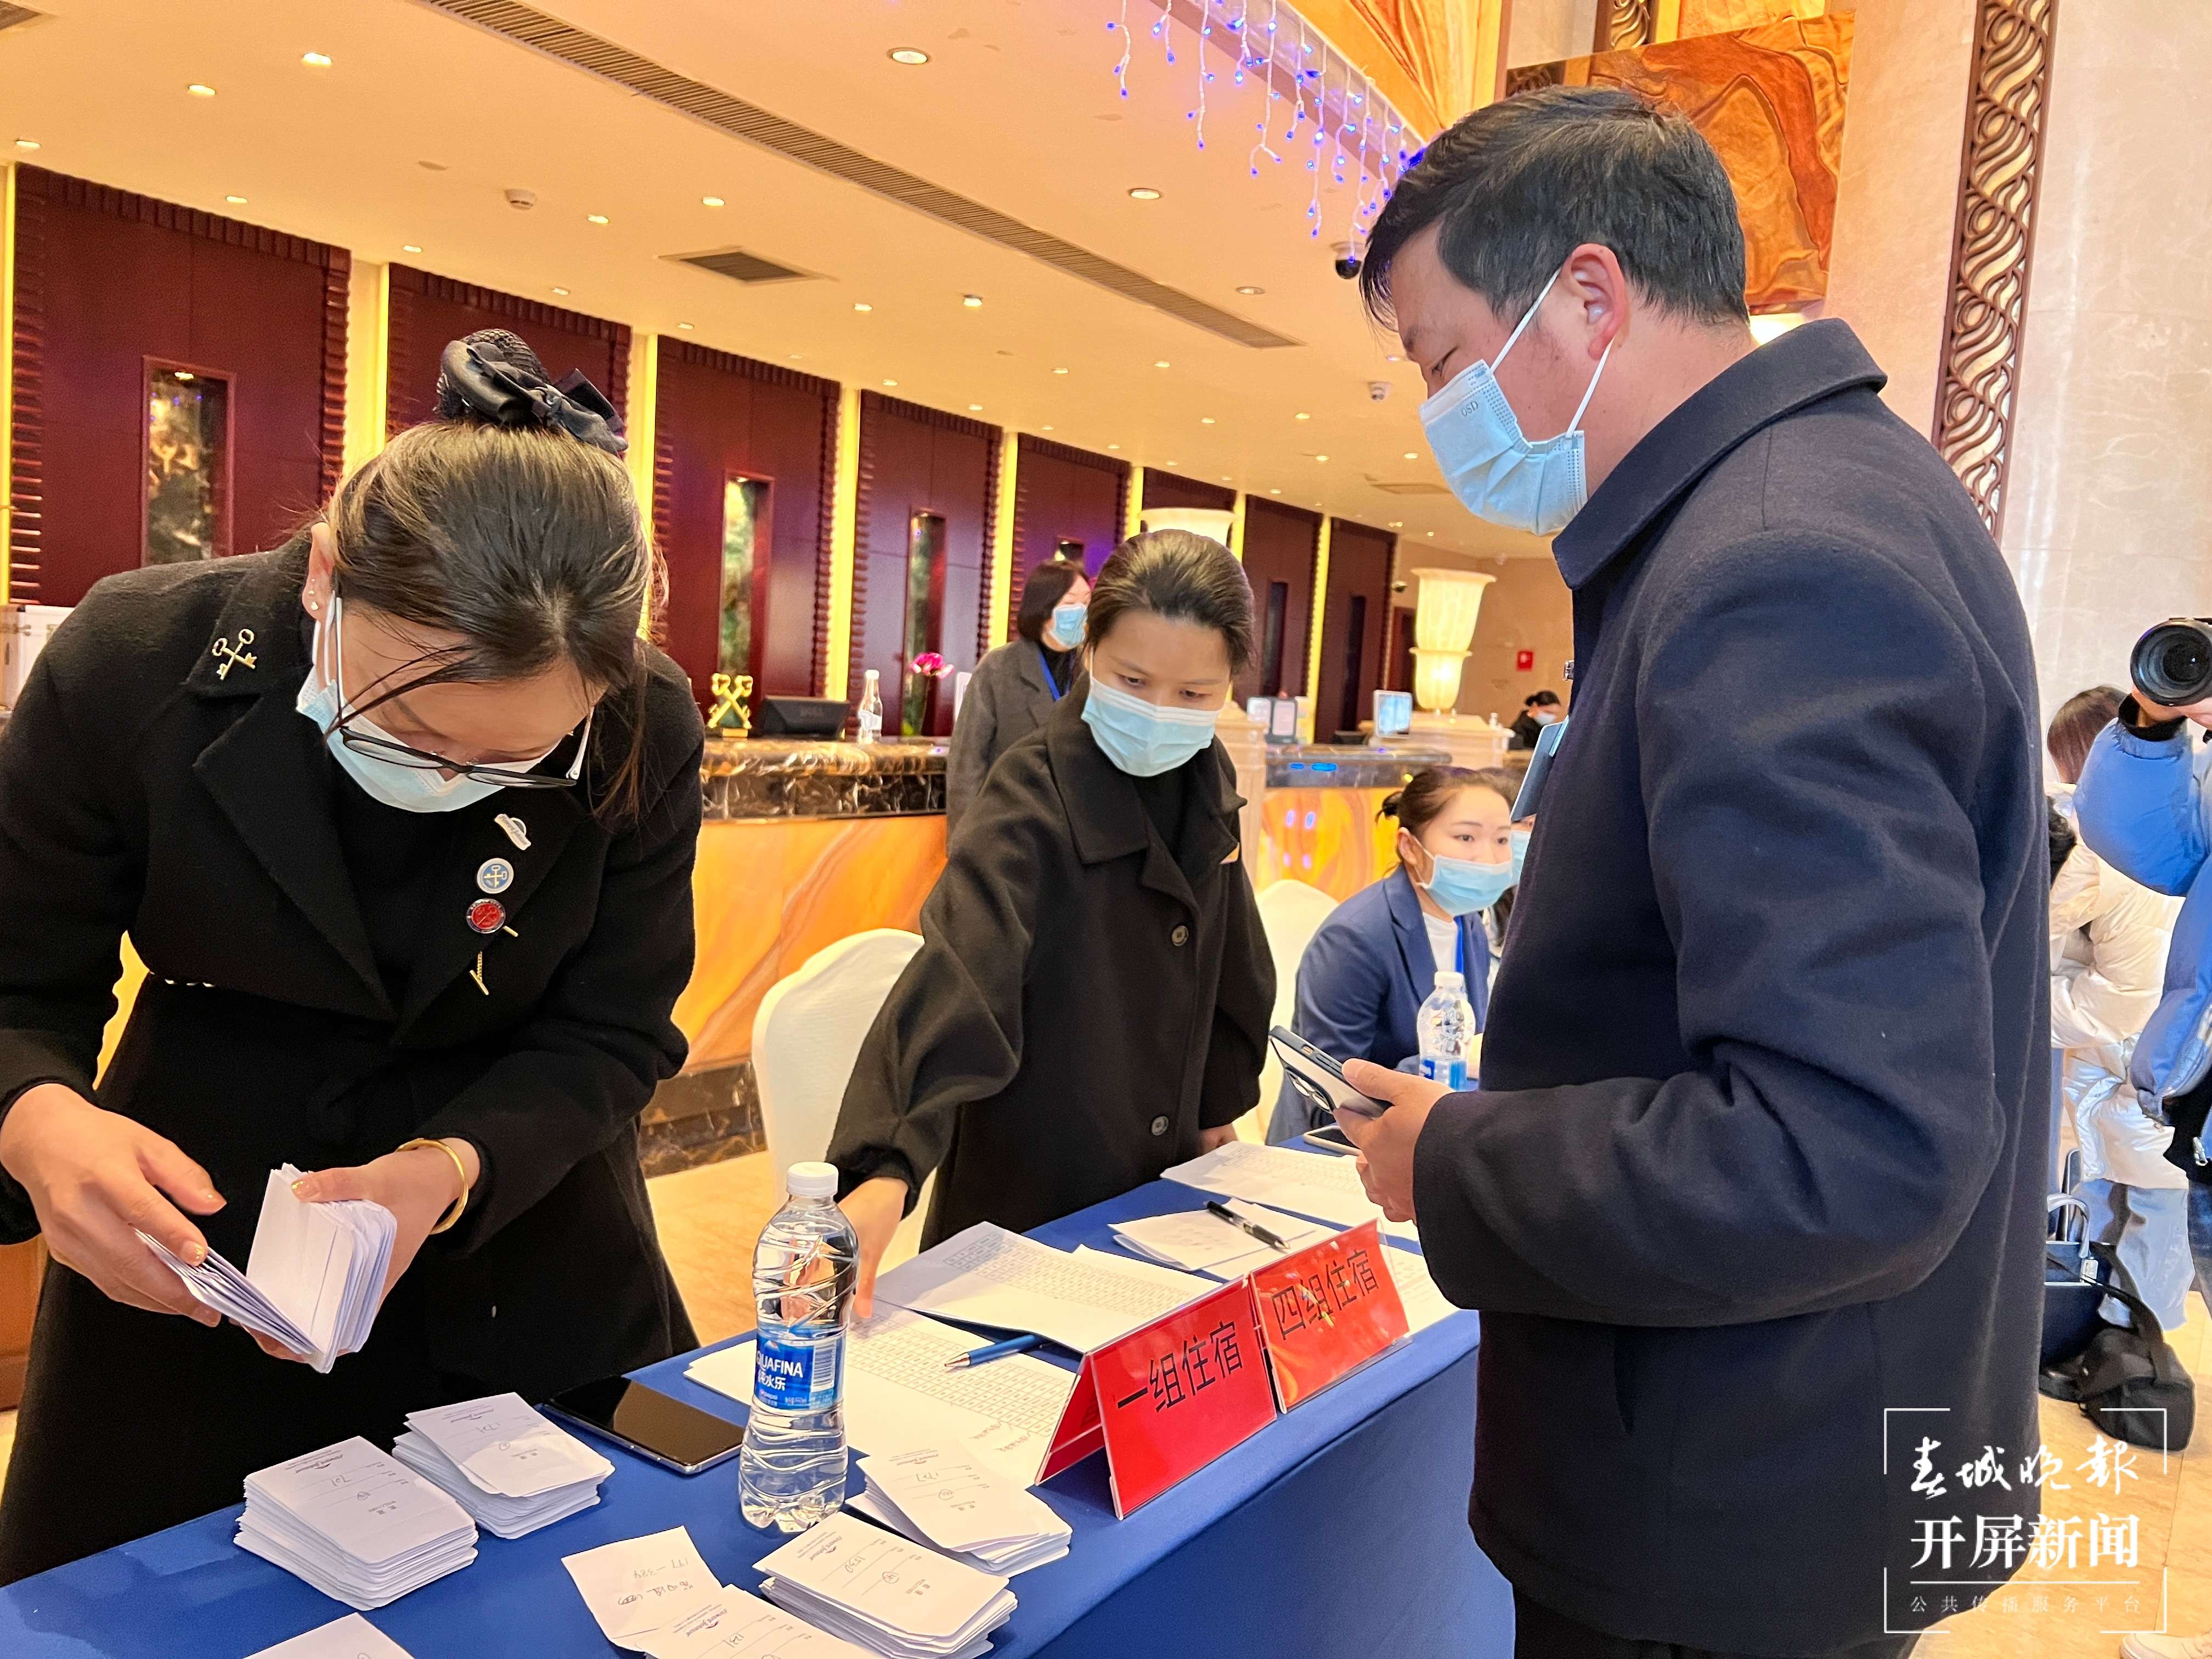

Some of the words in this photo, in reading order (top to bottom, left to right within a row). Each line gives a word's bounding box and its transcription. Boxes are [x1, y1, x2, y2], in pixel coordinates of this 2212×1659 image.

[1271, 1248, 1380, 1340] 四组住宿
[1116, 1320, 1244, 1413] 一组住宿
